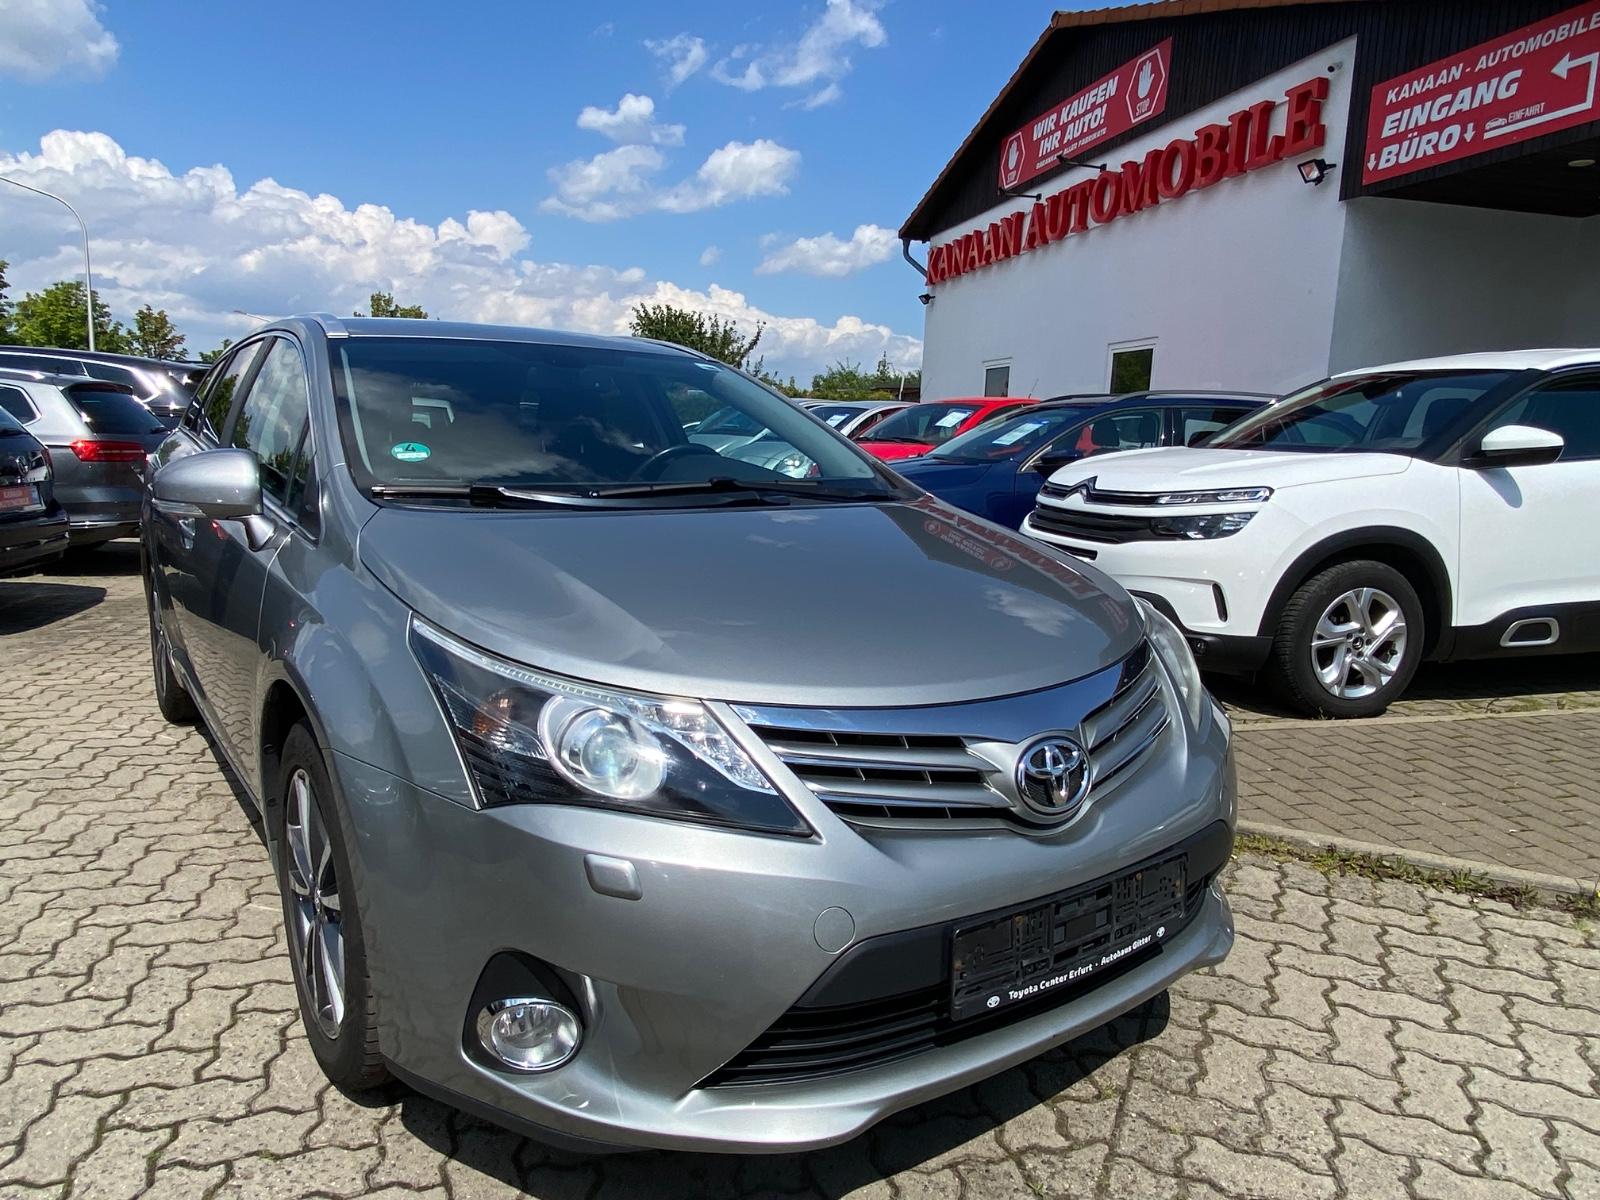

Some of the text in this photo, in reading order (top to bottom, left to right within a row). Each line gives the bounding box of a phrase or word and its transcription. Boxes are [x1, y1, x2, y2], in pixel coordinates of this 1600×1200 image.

[1386, 63, 1464, 105] KANAAN
[1474, 12, 1600, 73] AUTOMOBILE
[1032, 75, 1119, 141] WIR KAUFEN
[1038, 104, 1108, 157] IHR AUTO!
[1136, 98, 1150, 116] STOP
[1381, 69, 1523, 138] EINGANG
[1508, 102, 1546, 123] EINFAHRT
[1377, 124, 1462, 170] BÜRO
[926, 77, 1329, 286] KANAAN AUTOMOBILE
[1008, 982, 1038, 1001] Toyota
[1039, 973, 1068, 990] Center
[1069, 963, 1093, 981] Erfurt
[1100, 943, 1132, 966] Autohaus
